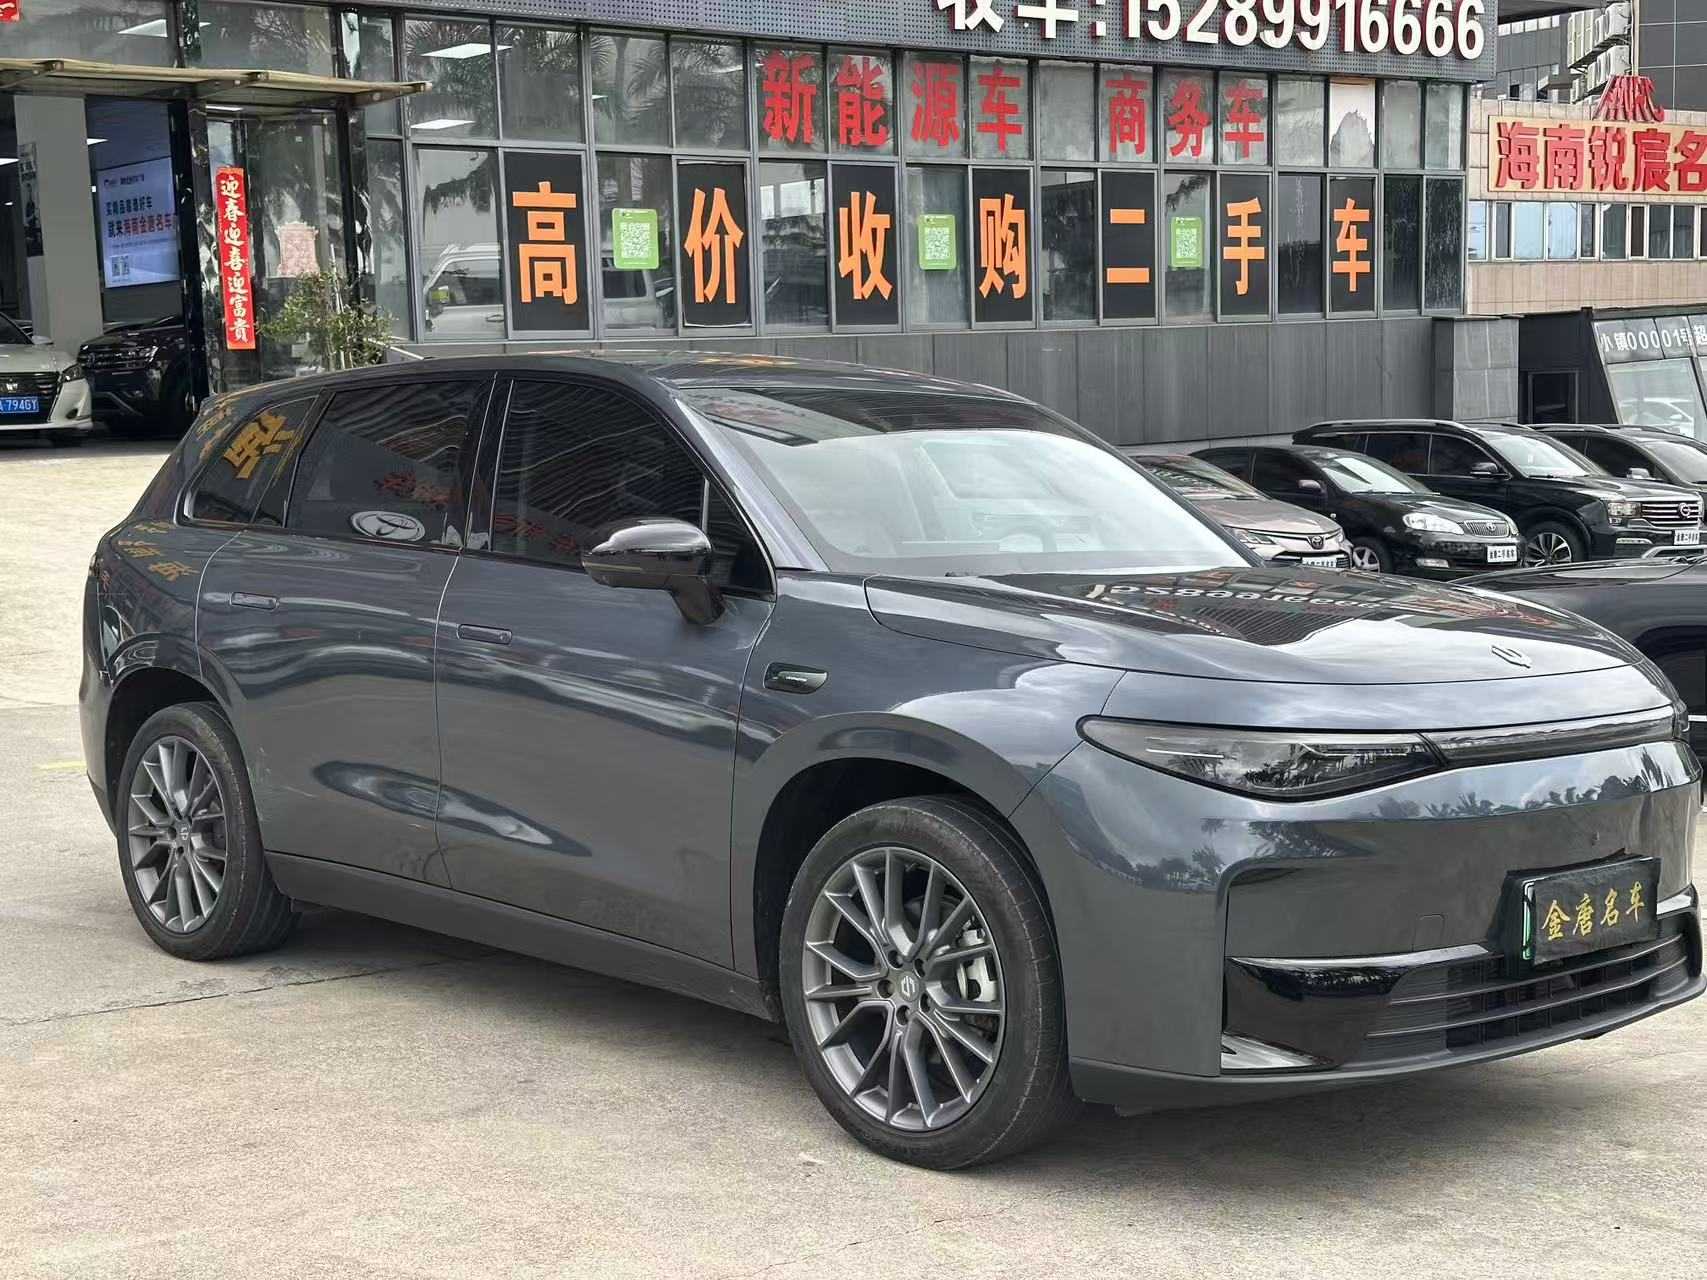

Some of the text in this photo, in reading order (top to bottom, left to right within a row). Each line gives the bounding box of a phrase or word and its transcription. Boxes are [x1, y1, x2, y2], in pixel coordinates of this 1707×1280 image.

[762, 54, 1266, 158] 新能源车 商务车
[511, 181, 1371, 304] 高价收购二手车
[1540, 880, 1645, 941] 金唐名车
